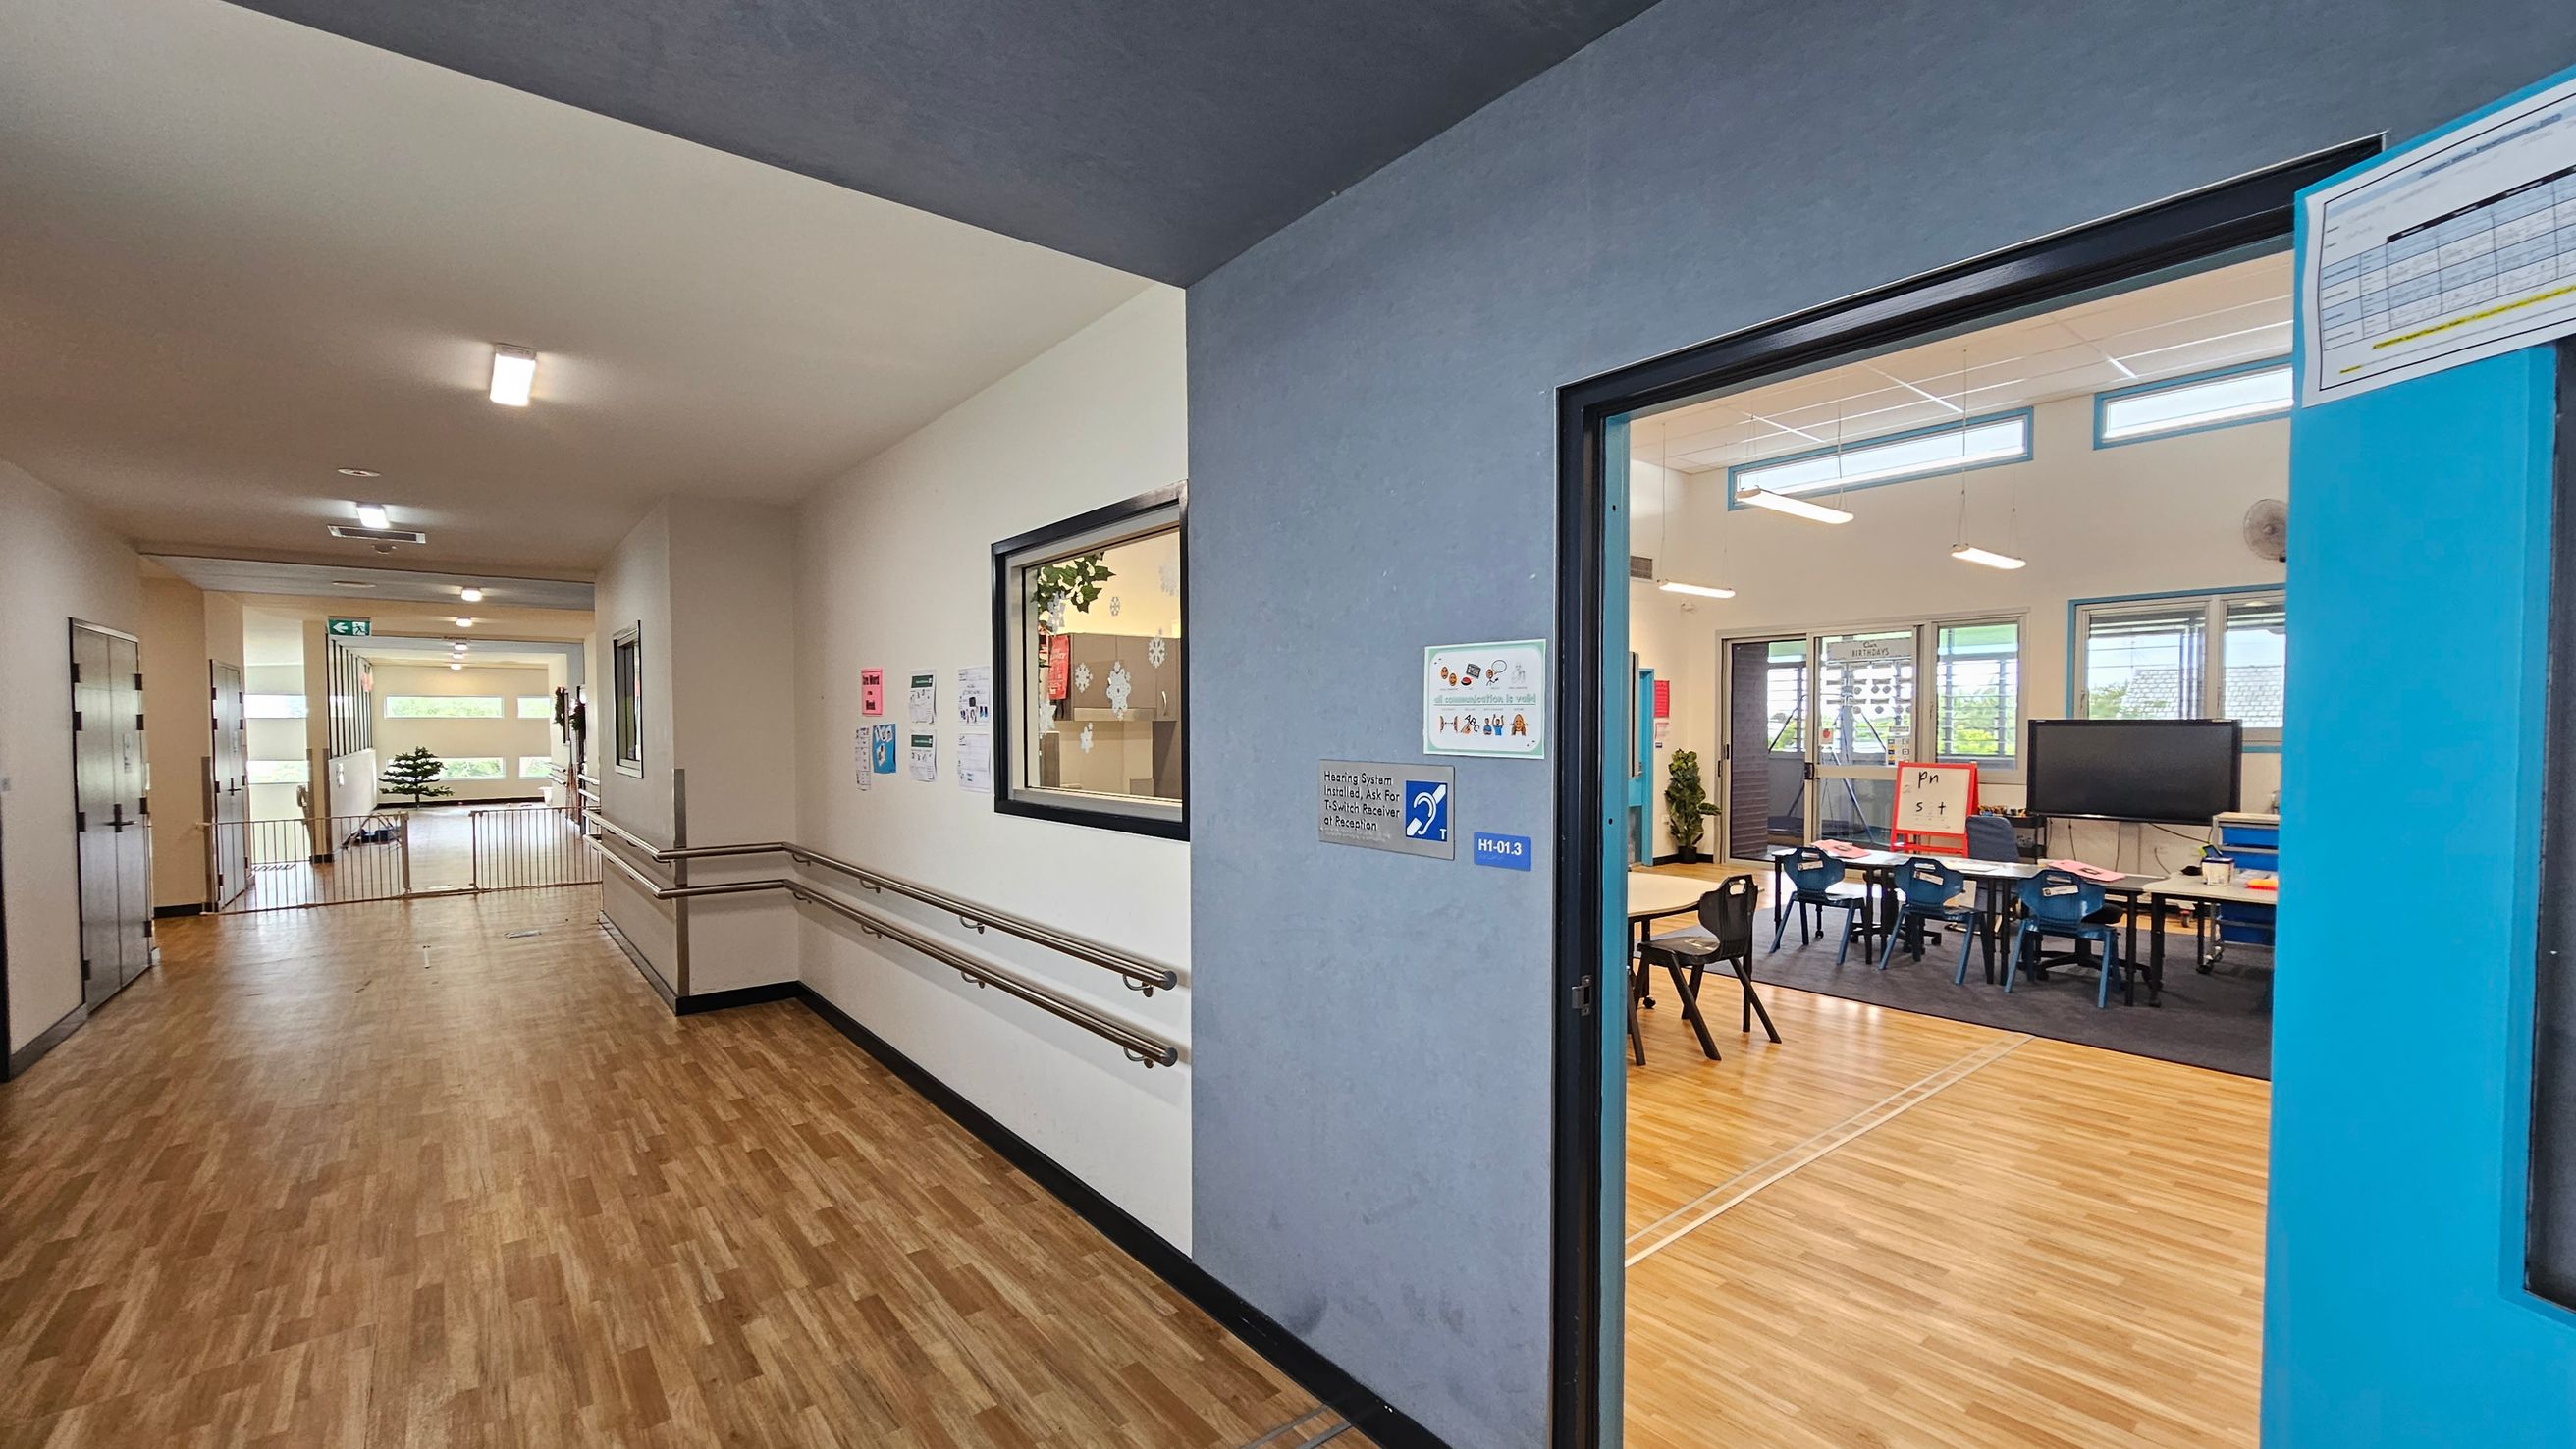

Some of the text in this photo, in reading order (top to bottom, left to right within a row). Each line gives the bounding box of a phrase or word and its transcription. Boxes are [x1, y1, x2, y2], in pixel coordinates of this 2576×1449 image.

[1852, 648, 1890, 657] BIRTHDAYS
[1445, 693, 1504, 703] communication
[1517, 693, 1536, 703] valid
[1324, 771, 1392, 786] Hearing System
[1324, 785, 1400, 802] Installed, Ask For
[1324, 800, 1400, 818] T-Switch Receiver
[1324, 816, 1377, 832] at Reception
[1439, 829, 1447, 840] T
[1478, 838, 1522, 855] H1-01.3
